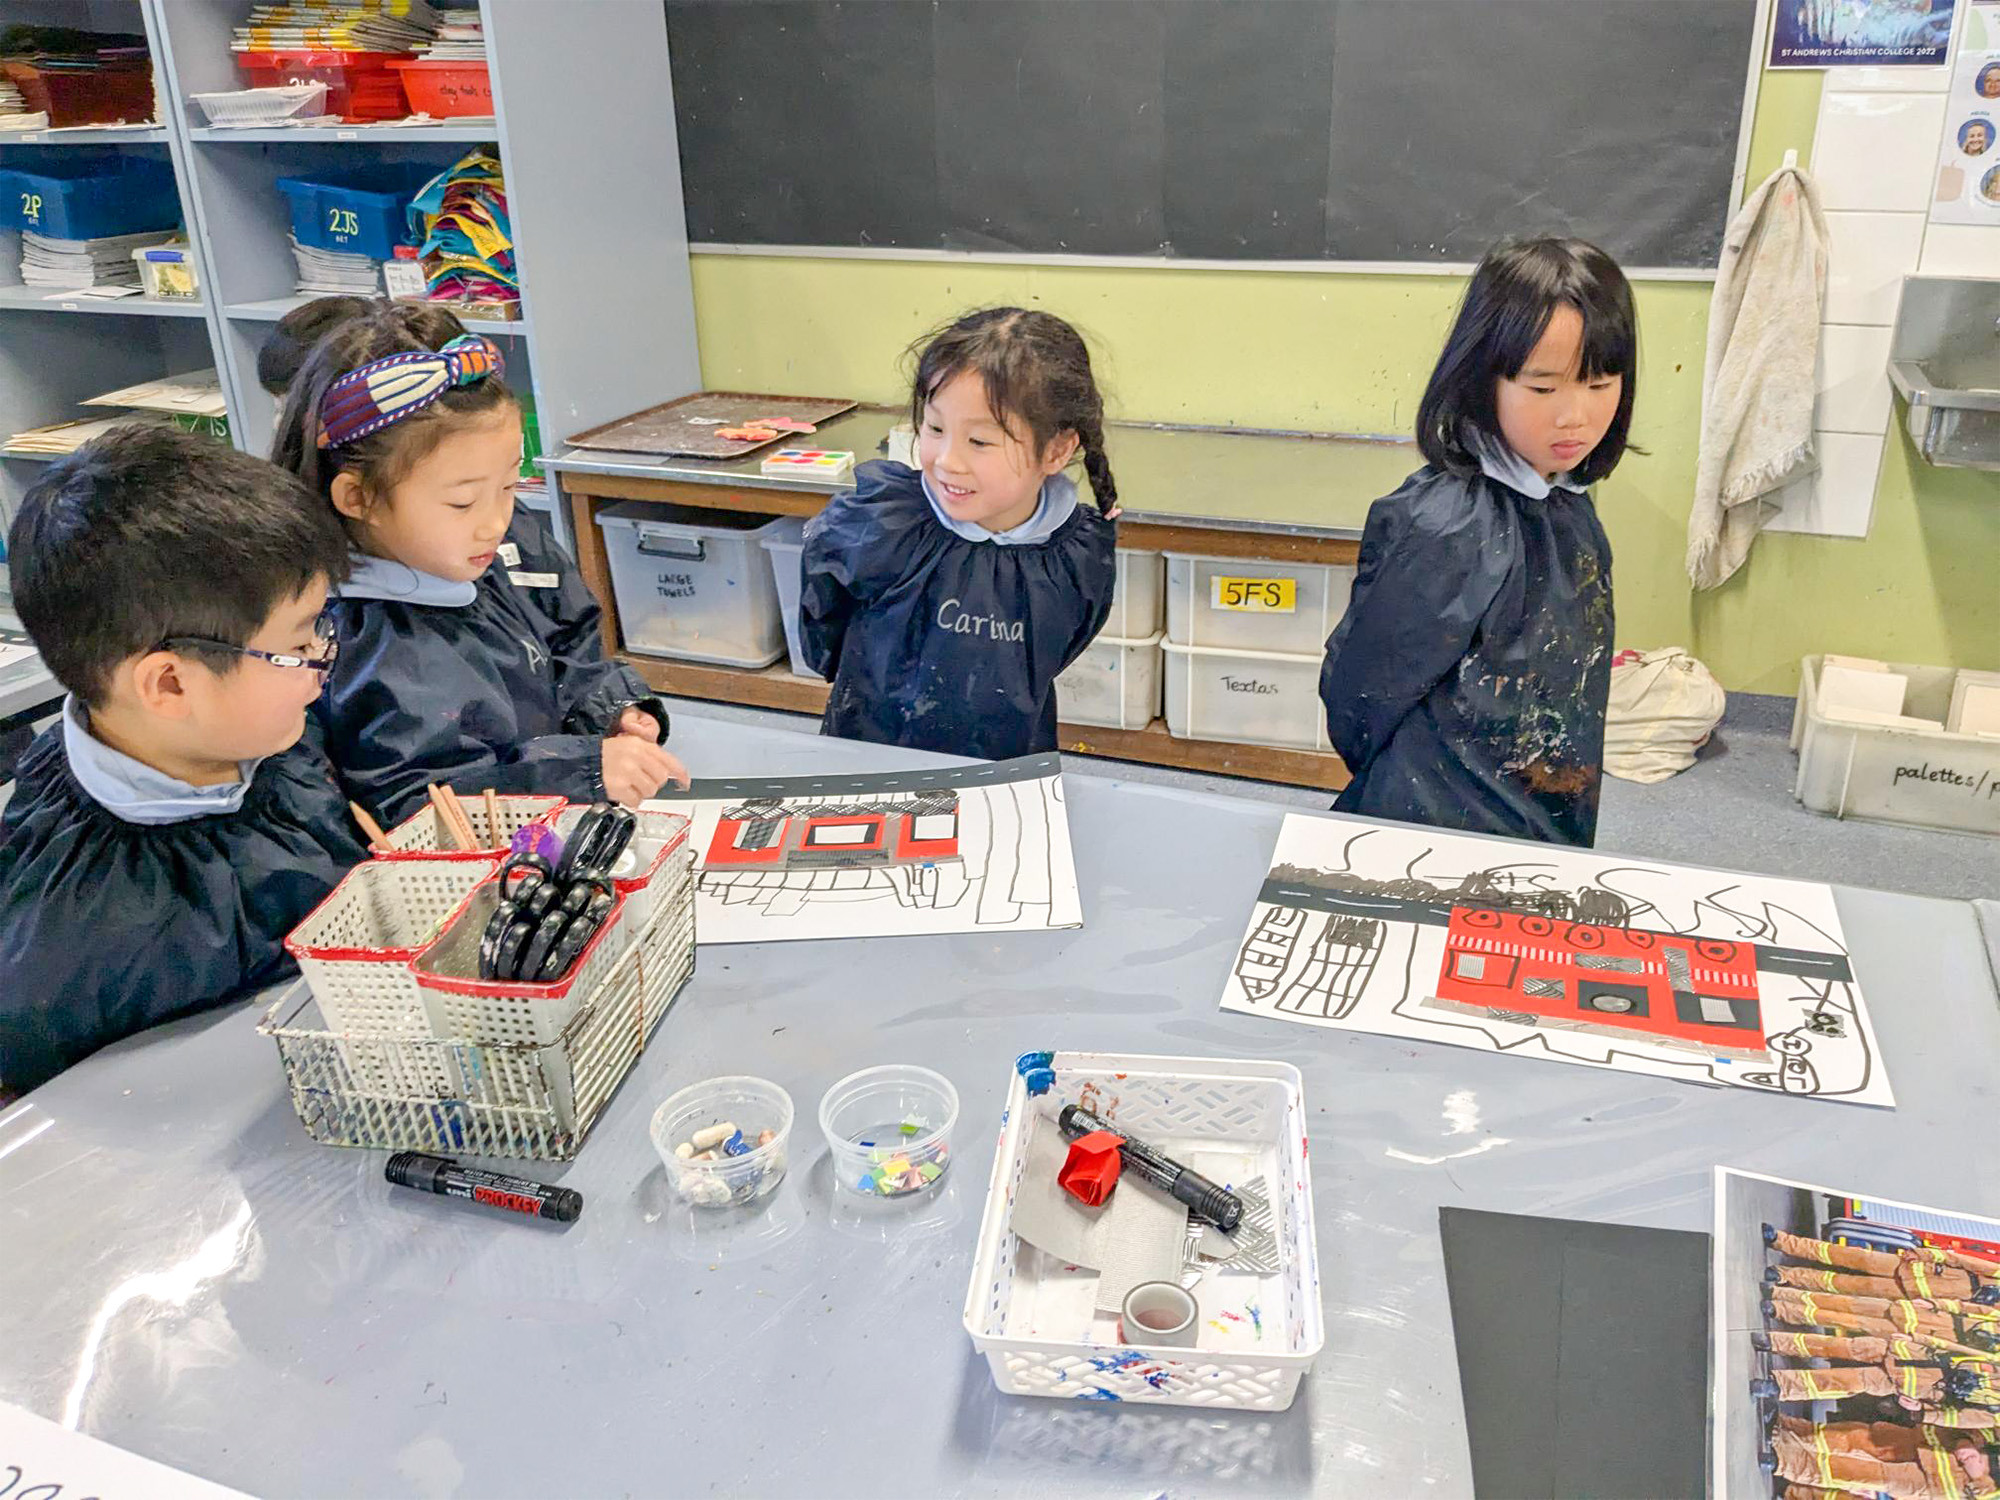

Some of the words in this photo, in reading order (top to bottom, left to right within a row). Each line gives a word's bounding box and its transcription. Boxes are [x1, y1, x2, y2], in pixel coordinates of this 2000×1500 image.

[1781, 48, 1792, 57] ST
[1792, 48, 1832, 57] ANDREWS
[1833, 47, 1877, 56] CHRISTIAN
[1877, 47, 1915, 56] COLLEGE
[1916, 47, 1937, 56] 2022
[21, 193, 42, 218] 2P
[330, 208, 359, 236] 2JS
[1226, 583, 1281, 607] 5FS
[937, 598, 1025, 642] Carina
[1220, 676, 1279, 694] Textas
[473, 1185, 543, 1217] PROCKEY
